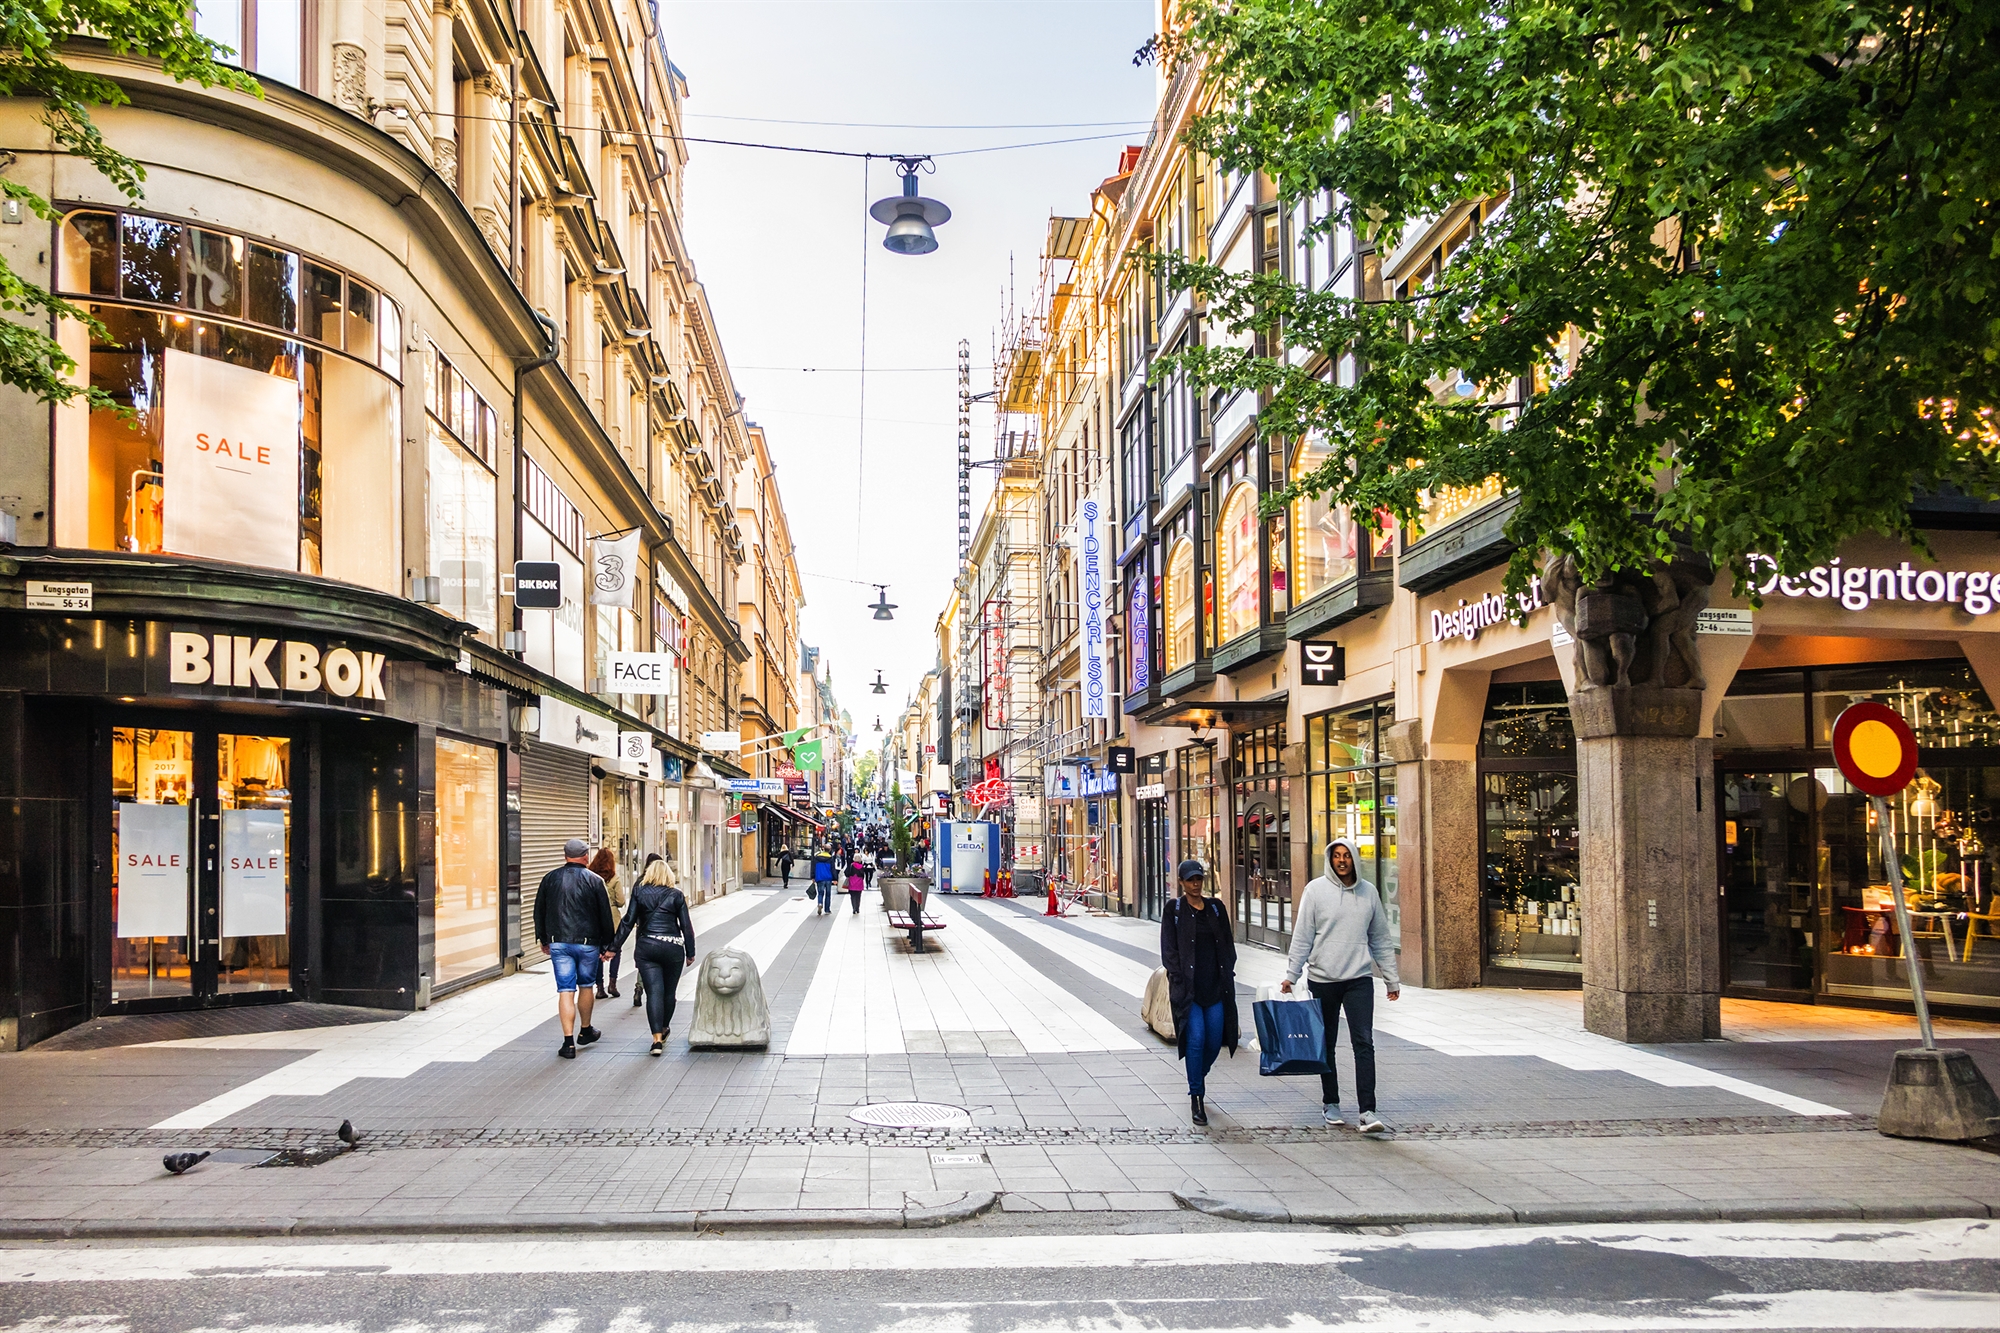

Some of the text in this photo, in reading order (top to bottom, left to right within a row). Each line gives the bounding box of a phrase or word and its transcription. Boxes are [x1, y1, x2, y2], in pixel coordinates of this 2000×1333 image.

[196, 432, 272, 465] SALE
[594, 554, 626, 593] 3
[43, 584, 89, 596] Kungsgatan
[63, 598, 89, 608] 56-54
[1084, 501, 1104, 716] SIDENCARLSON
[1697, 612, 1737, 620] ungsgatan
[614, 662, 661, 681] FACE
[627, 736, 645, 758] 3
[154, 763, 176, 771] 2017
[760, 782, 783, 791] TIARA
[127, 853, 181, 868] SALE
[230, 857, 279, 871] SALE
